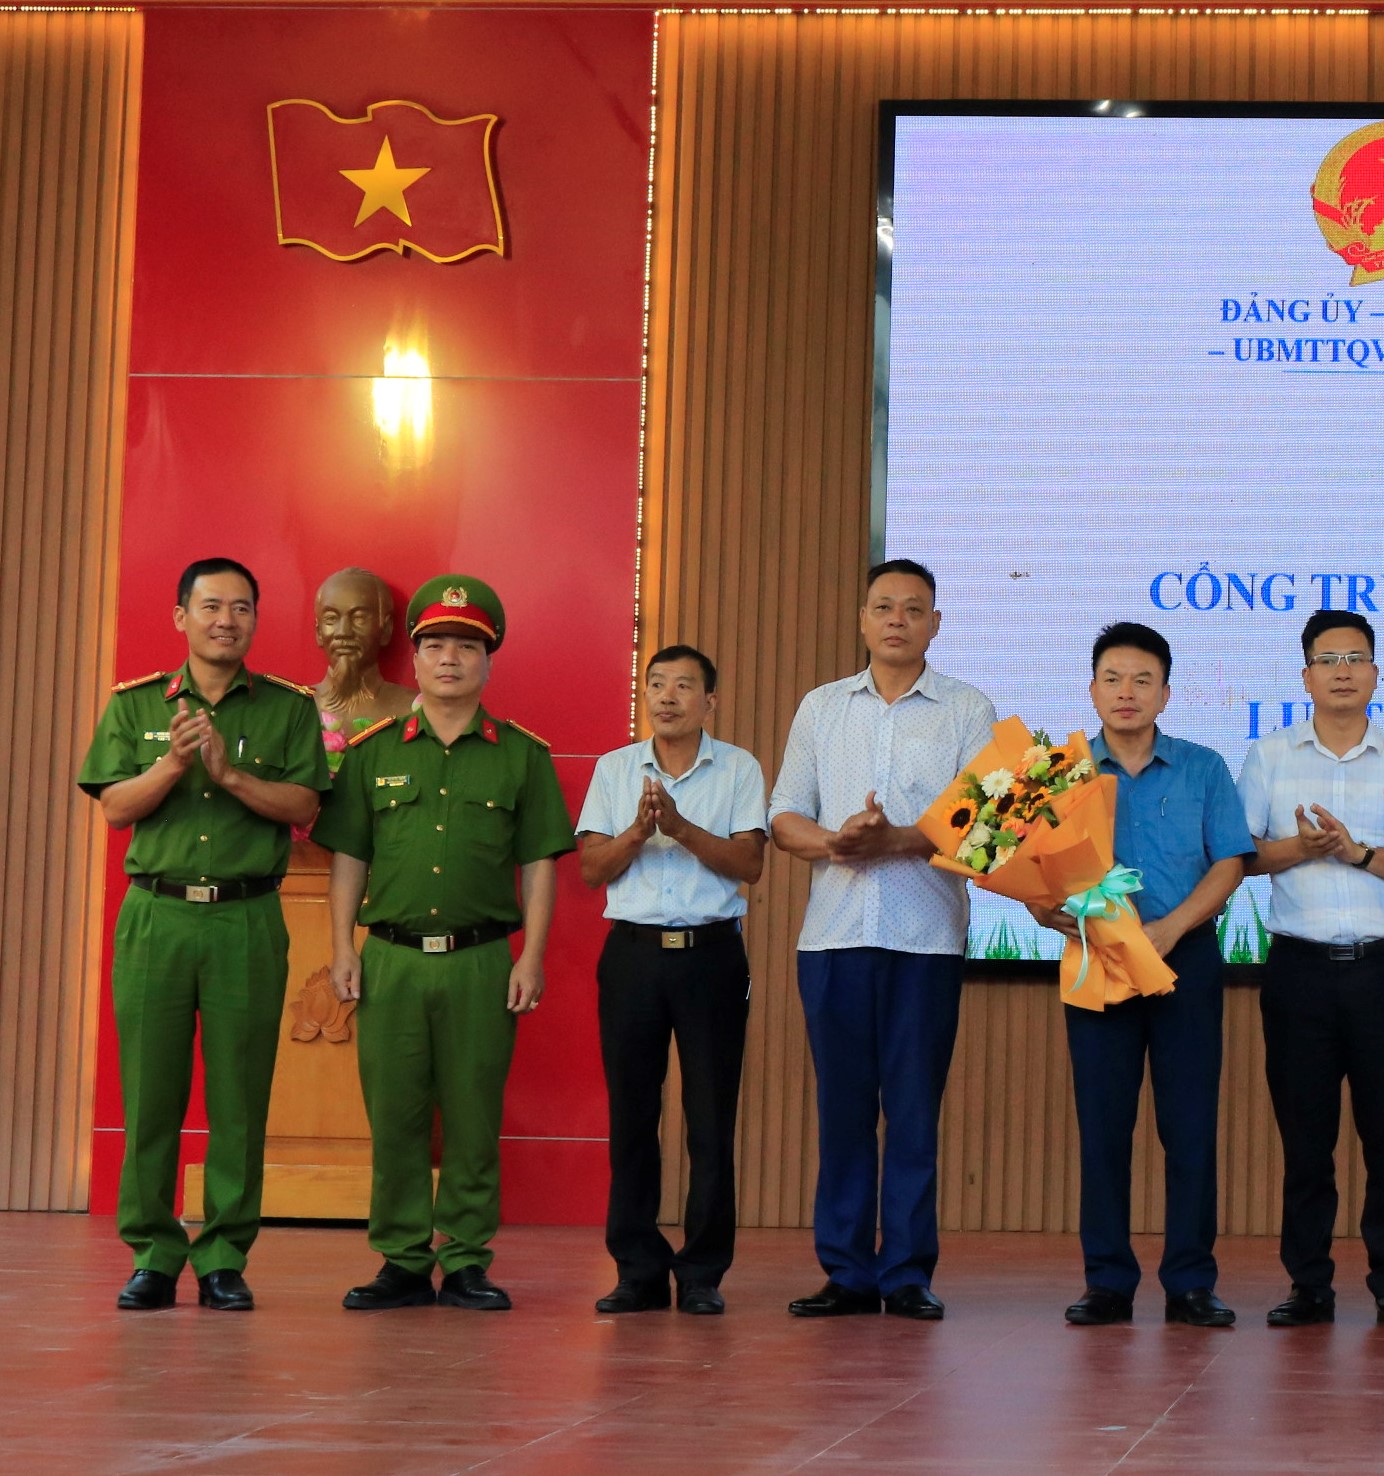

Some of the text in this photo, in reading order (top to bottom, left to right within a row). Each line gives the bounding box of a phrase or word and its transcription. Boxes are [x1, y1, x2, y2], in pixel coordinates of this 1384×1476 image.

[1220, 292, 1311, 323] ĐẢNG
[1320, 292, 1364, 323] ỦY
[1150, 561, 1297, 611] CỔNG
